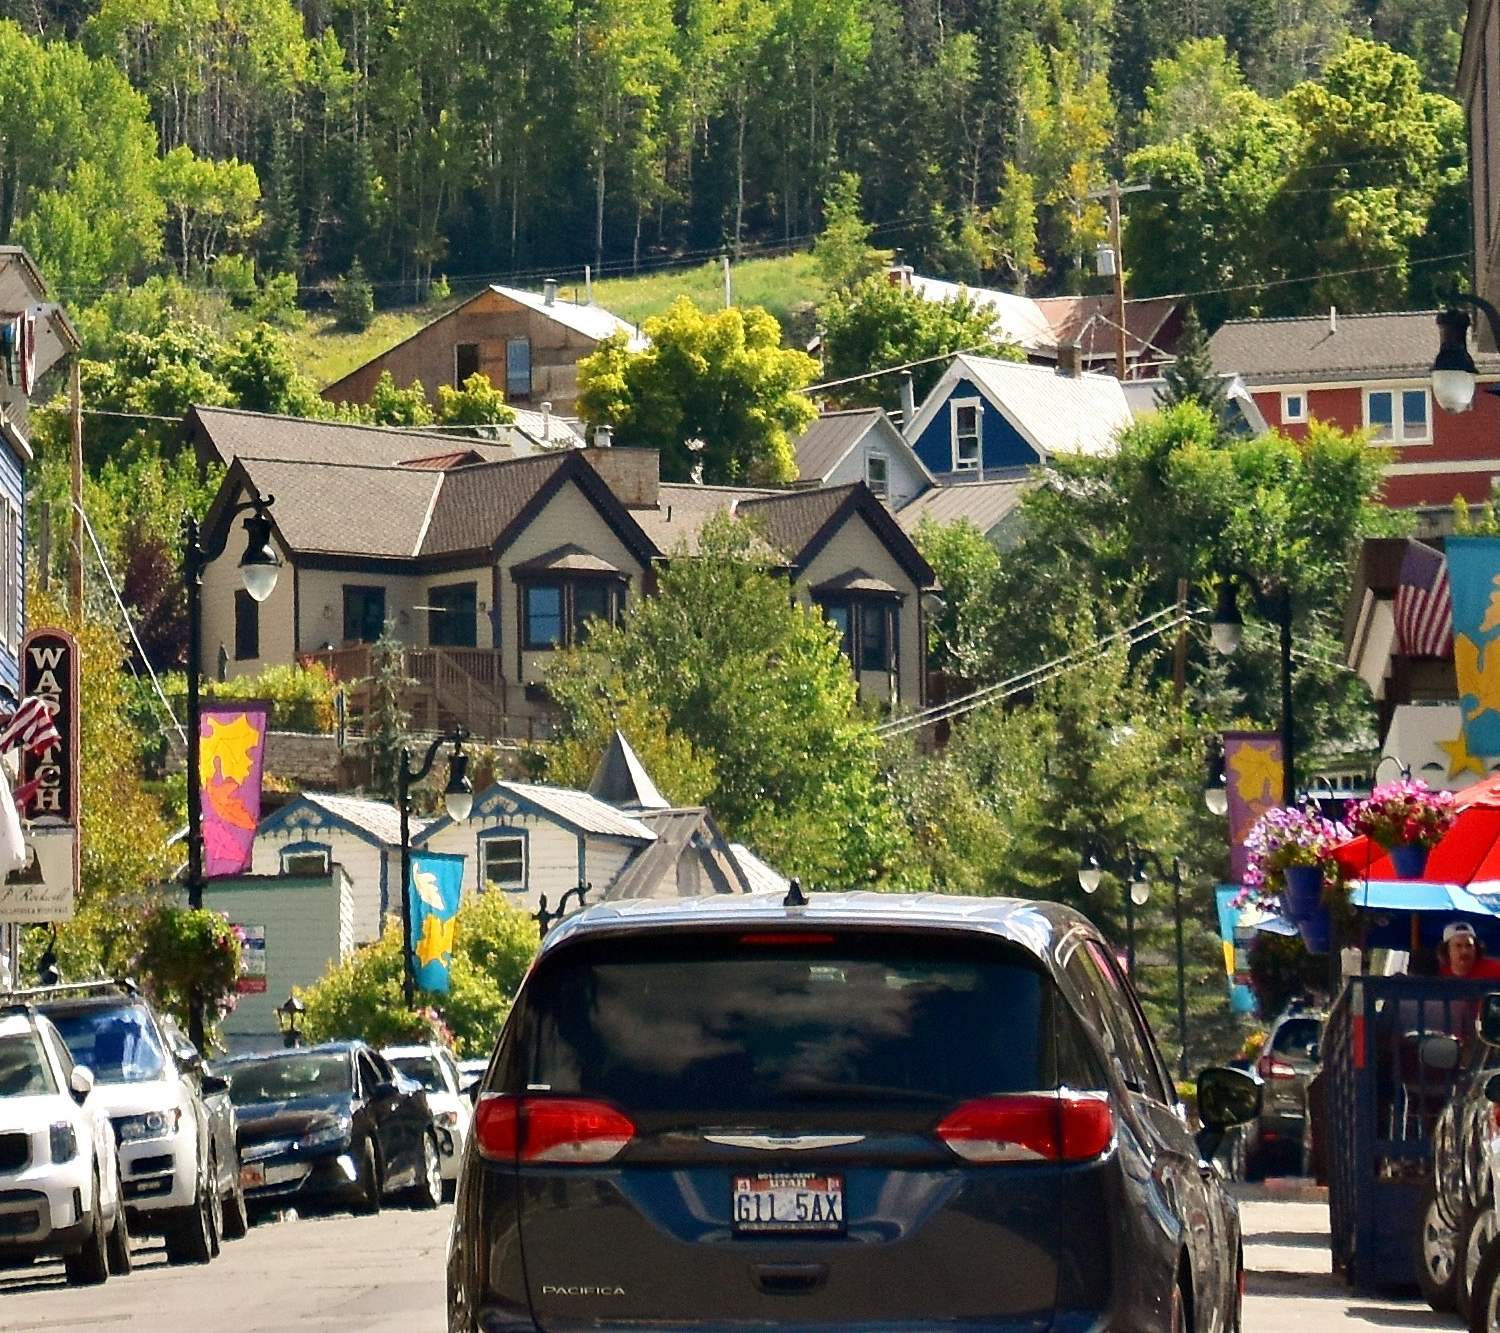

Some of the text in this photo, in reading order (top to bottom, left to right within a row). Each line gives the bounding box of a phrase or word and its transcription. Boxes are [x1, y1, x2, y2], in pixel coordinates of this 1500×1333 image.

[28, 647, 66, 811] WASTCH
[769, 1178, 807, 1188] UTAH
[795, 1193, 839, 1223] 5AX
[542, 1285, 625, 1295] PACIFICA
